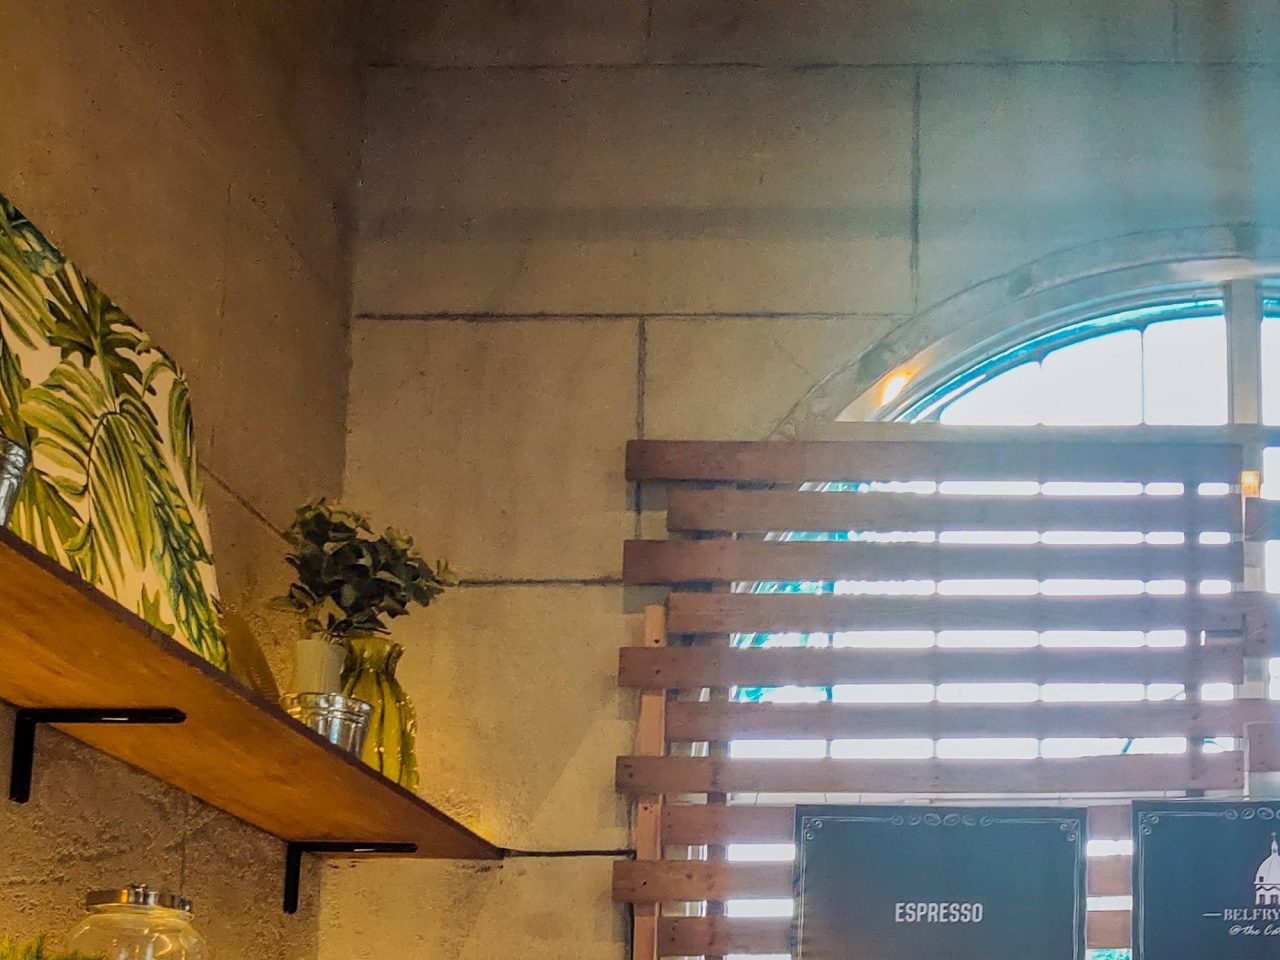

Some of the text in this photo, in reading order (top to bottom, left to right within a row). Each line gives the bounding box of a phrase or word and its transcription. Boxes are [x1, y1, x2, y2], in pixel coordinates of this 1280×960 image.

[895, 902, 983, 923] ESPRESSO
[1223, 908, 1280, 921] BELFRY
[1229, 924, 1260, 937] @the
